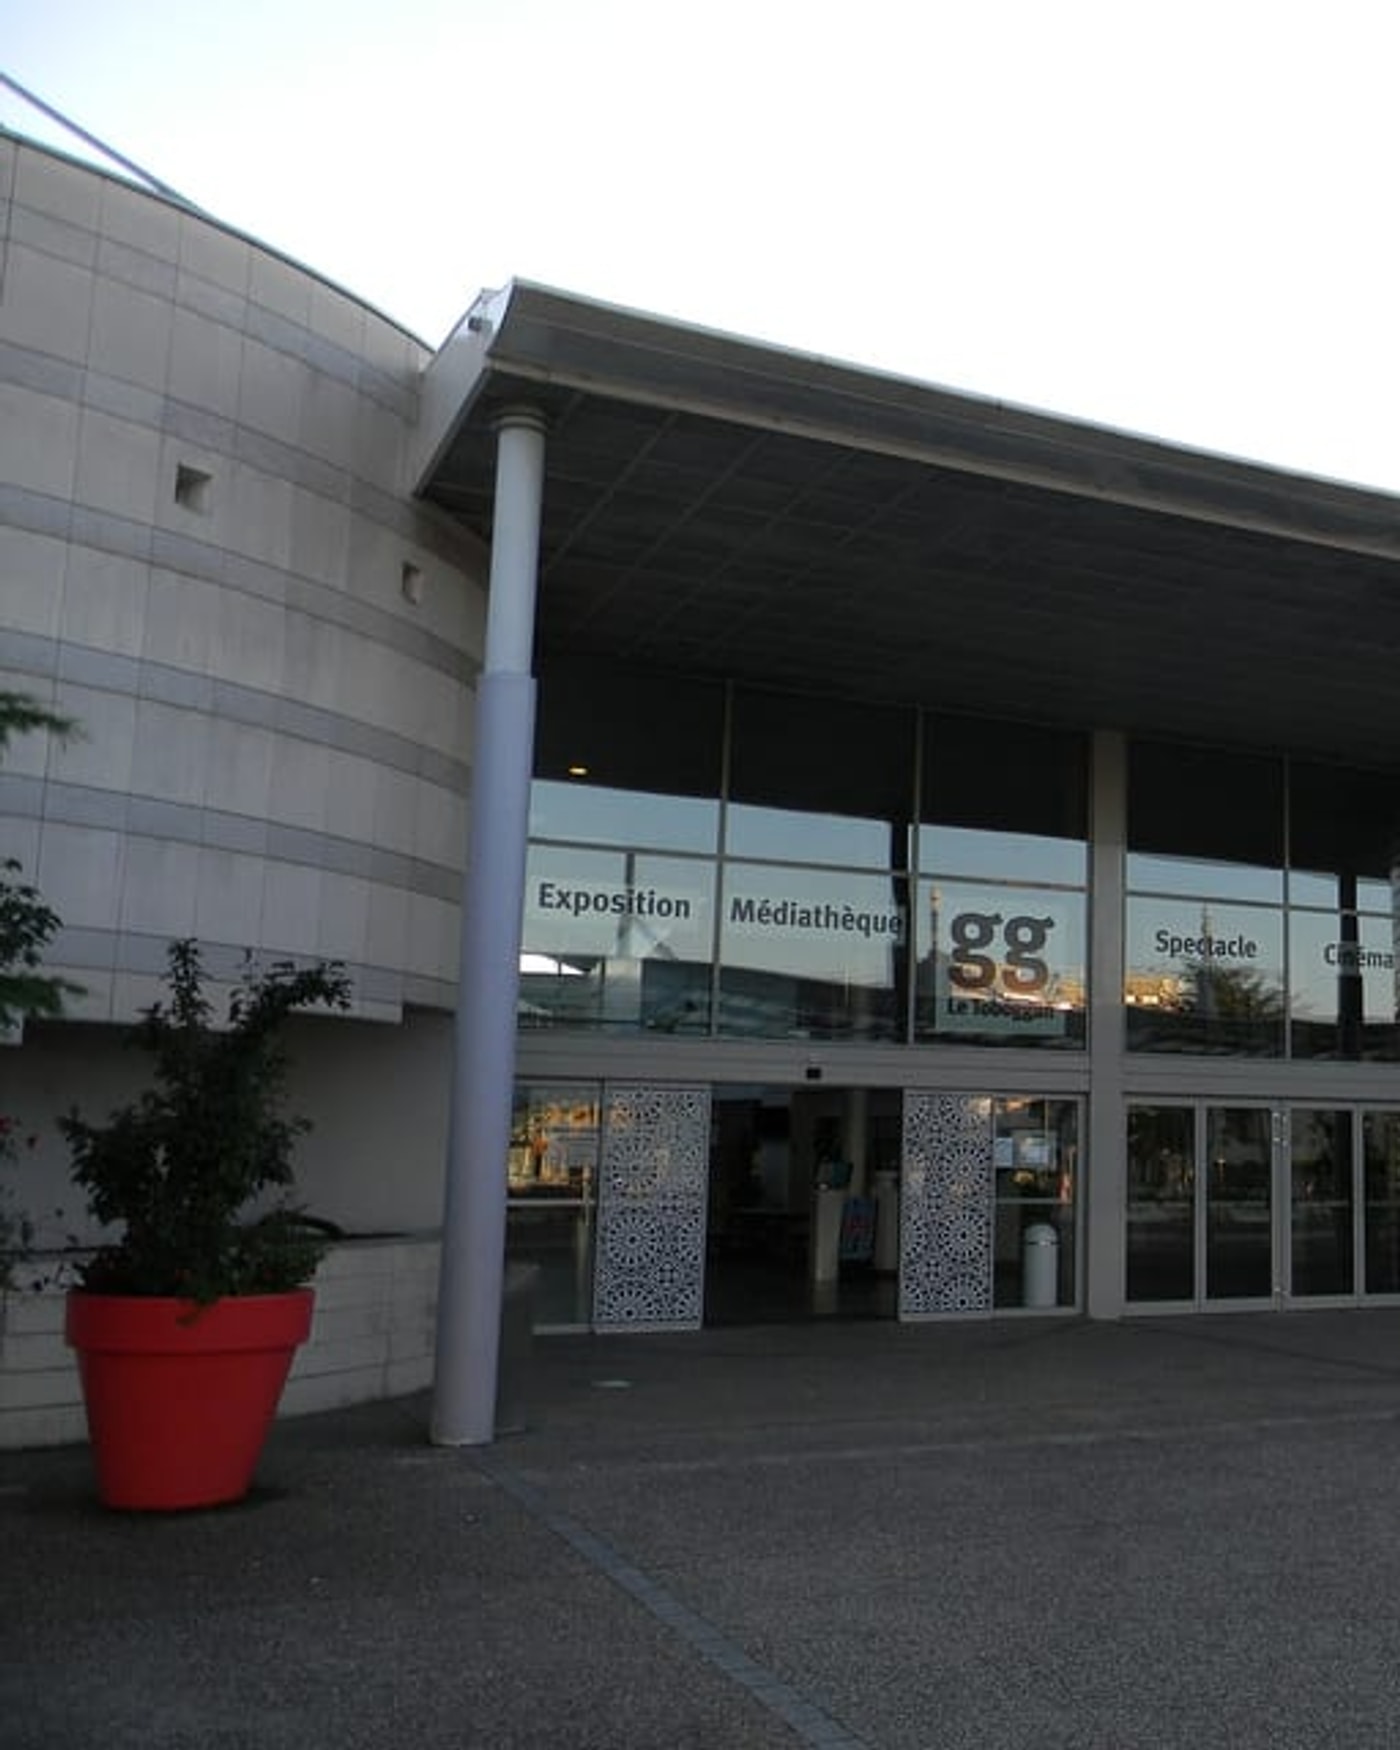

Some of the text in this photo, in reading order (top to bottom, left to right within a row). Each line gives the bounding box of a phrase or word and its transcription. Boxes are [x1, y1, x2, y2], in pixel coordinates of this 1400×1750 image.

[538, 882, 691, 919] Exposition
[730, 898, 902, 938] Médiathèque
[948, 913, 1055, 993] gg
[1155, 929, 1258, 958] Spectacle
